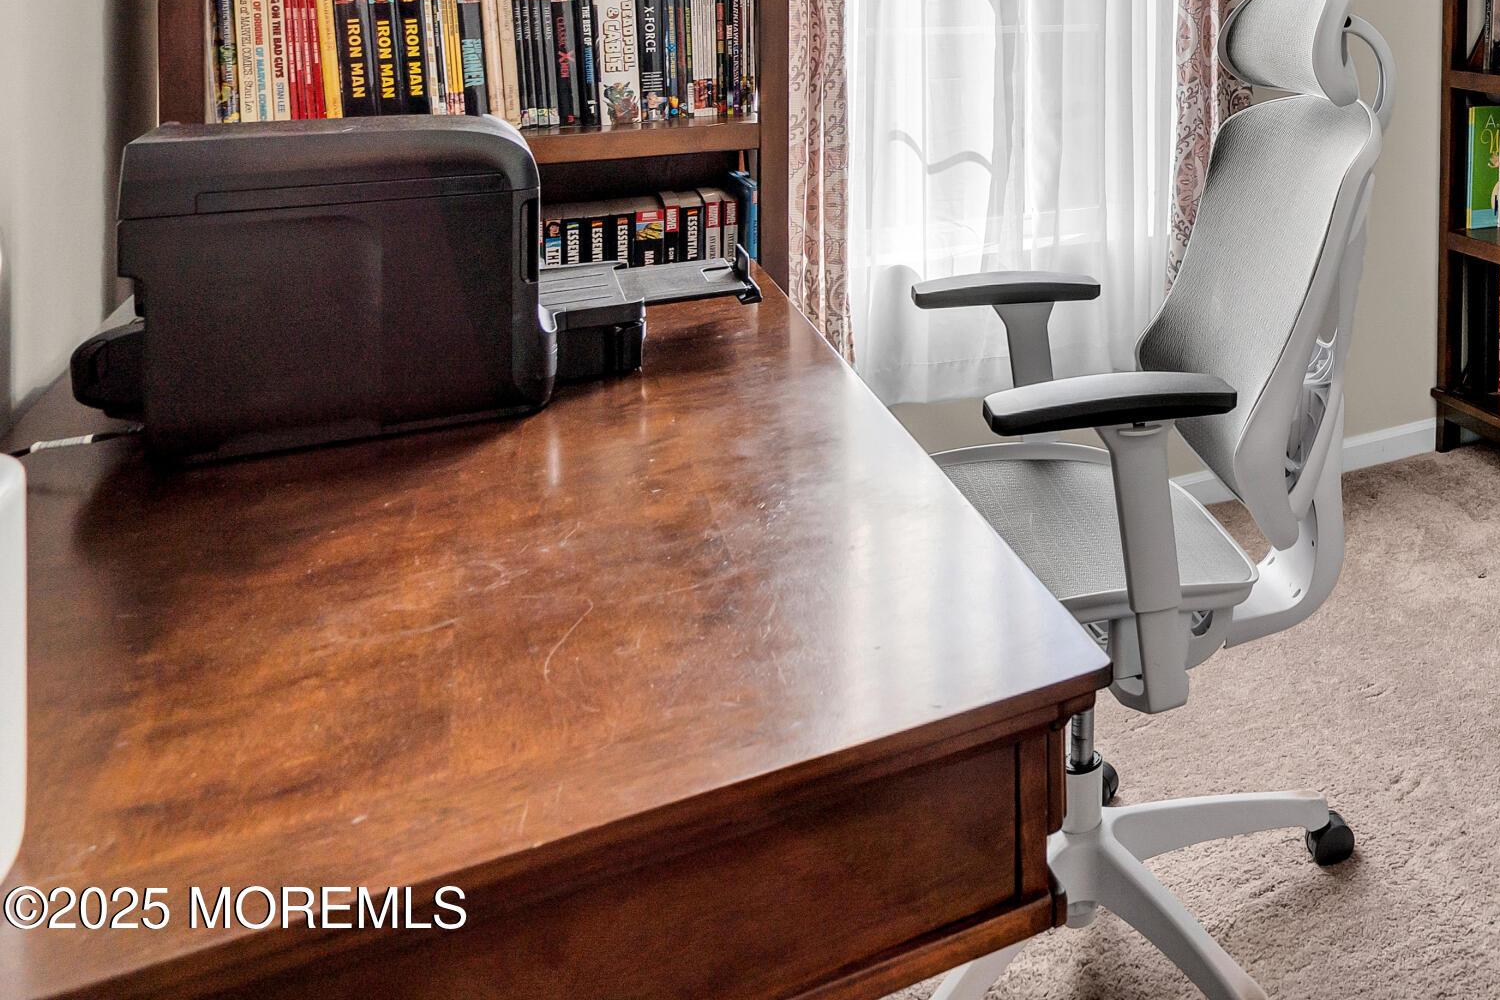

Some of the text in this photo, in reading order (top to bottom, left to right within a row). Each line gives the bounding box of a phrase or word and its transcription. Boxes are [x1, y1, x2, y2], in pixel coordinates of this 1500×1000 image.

[252, 2, 262, 11] OF
[271, 6, 282, 19] ON
[241, 17, 251, 46] MARVEL
[253, 13, 264, 45] ORIGINS
[272, 21, 282, 36] THE
[603, 8, 622, 72] & CABLE
[621, 0, 635, 72] DEADPOOL
[644, 6, 656, 53] X-FORCE
[254, 47, 265, 57] OF
[273, 38, 283, 56] BAD
[347, 19, 365, 98] IRON MAN
[404, 19, 423, 96] IRON MAN
[581, 6, 594, 84] THE BEST OF WOLVERINE
[274, 57, 284, 78] GUYS
[376, 20, 395, 98] IRON MAN
[255, 59, 266, 92] MARVEL
[244, 81, 255, 98] Stan
[276, 82, 285, 99] STAN
[244, 101, 253, 113] Lee
[257, 94, 268, 121] COMIC
[277, 101, 286, 112] LEE
[666, 208, 676, 230] MARVEL
[687, 216, 698, 259] ESSENTIAL
